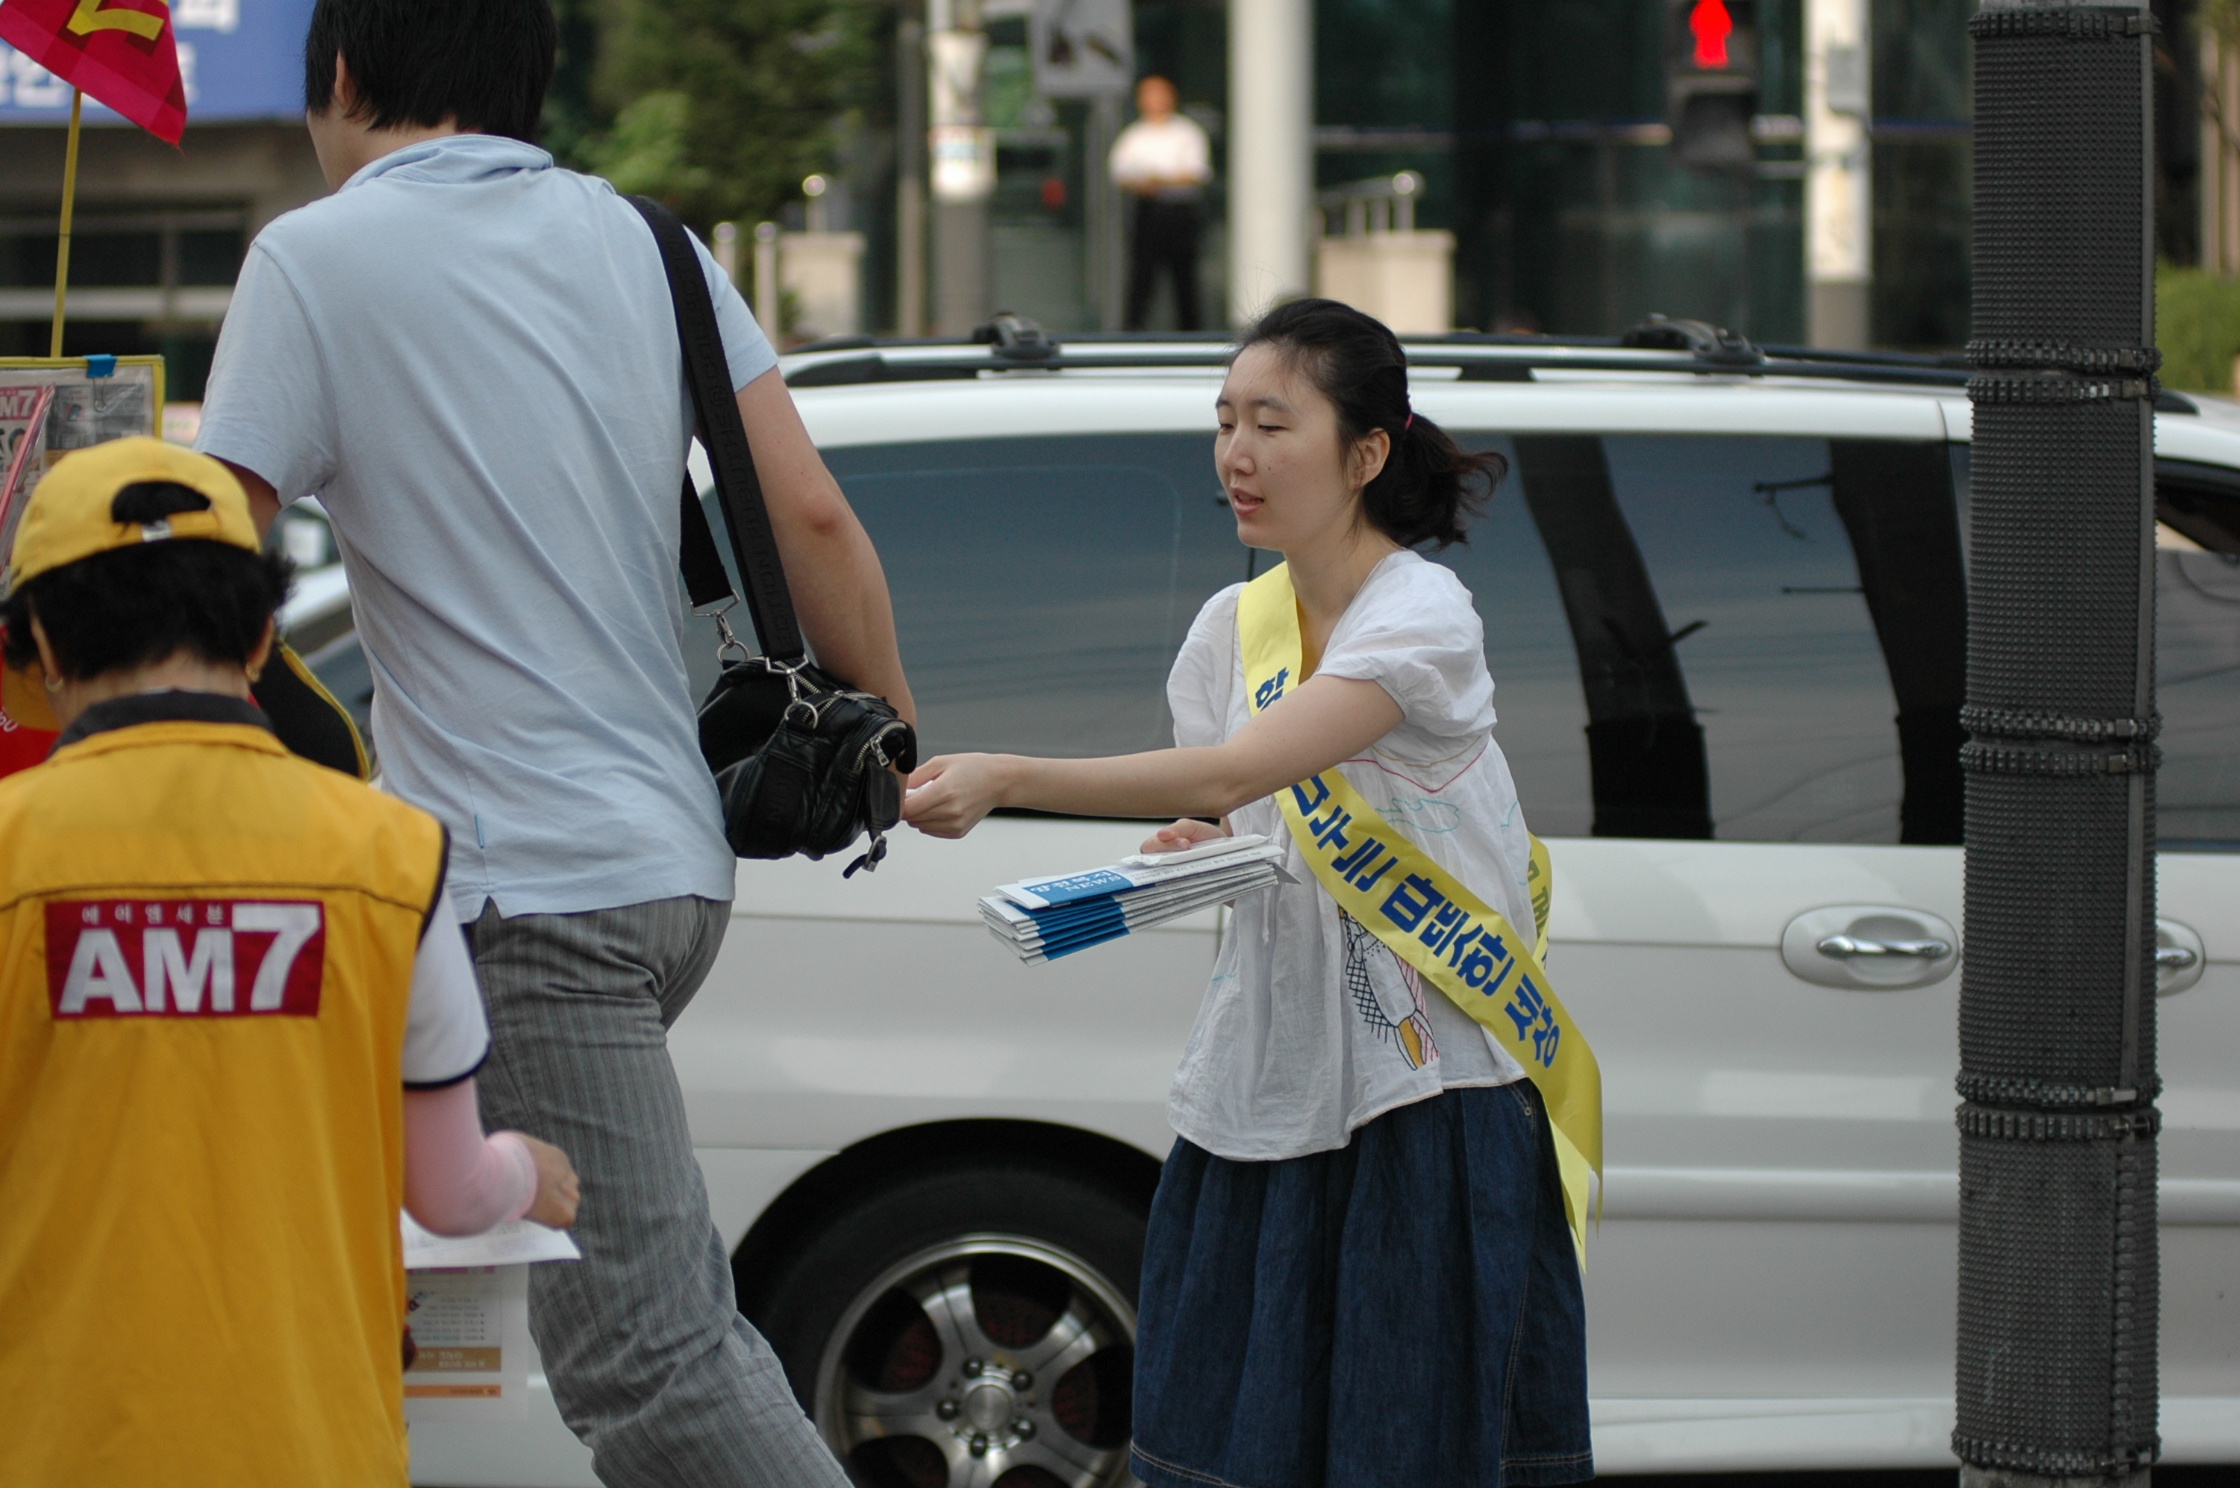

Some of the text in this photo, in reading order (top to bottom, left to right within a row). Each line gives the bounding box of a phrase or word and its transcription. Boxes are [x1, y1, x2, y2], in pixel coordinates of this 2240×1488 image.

[81, 902, 224, 925] 에이엠세븐
[1065, 875, 1121, 891] NEWS
[58, 902, 320, 1014] AM7
[1379, 873, 1516, 996] 따뜻한
[1504, 972, 1560, 1068] 세상
